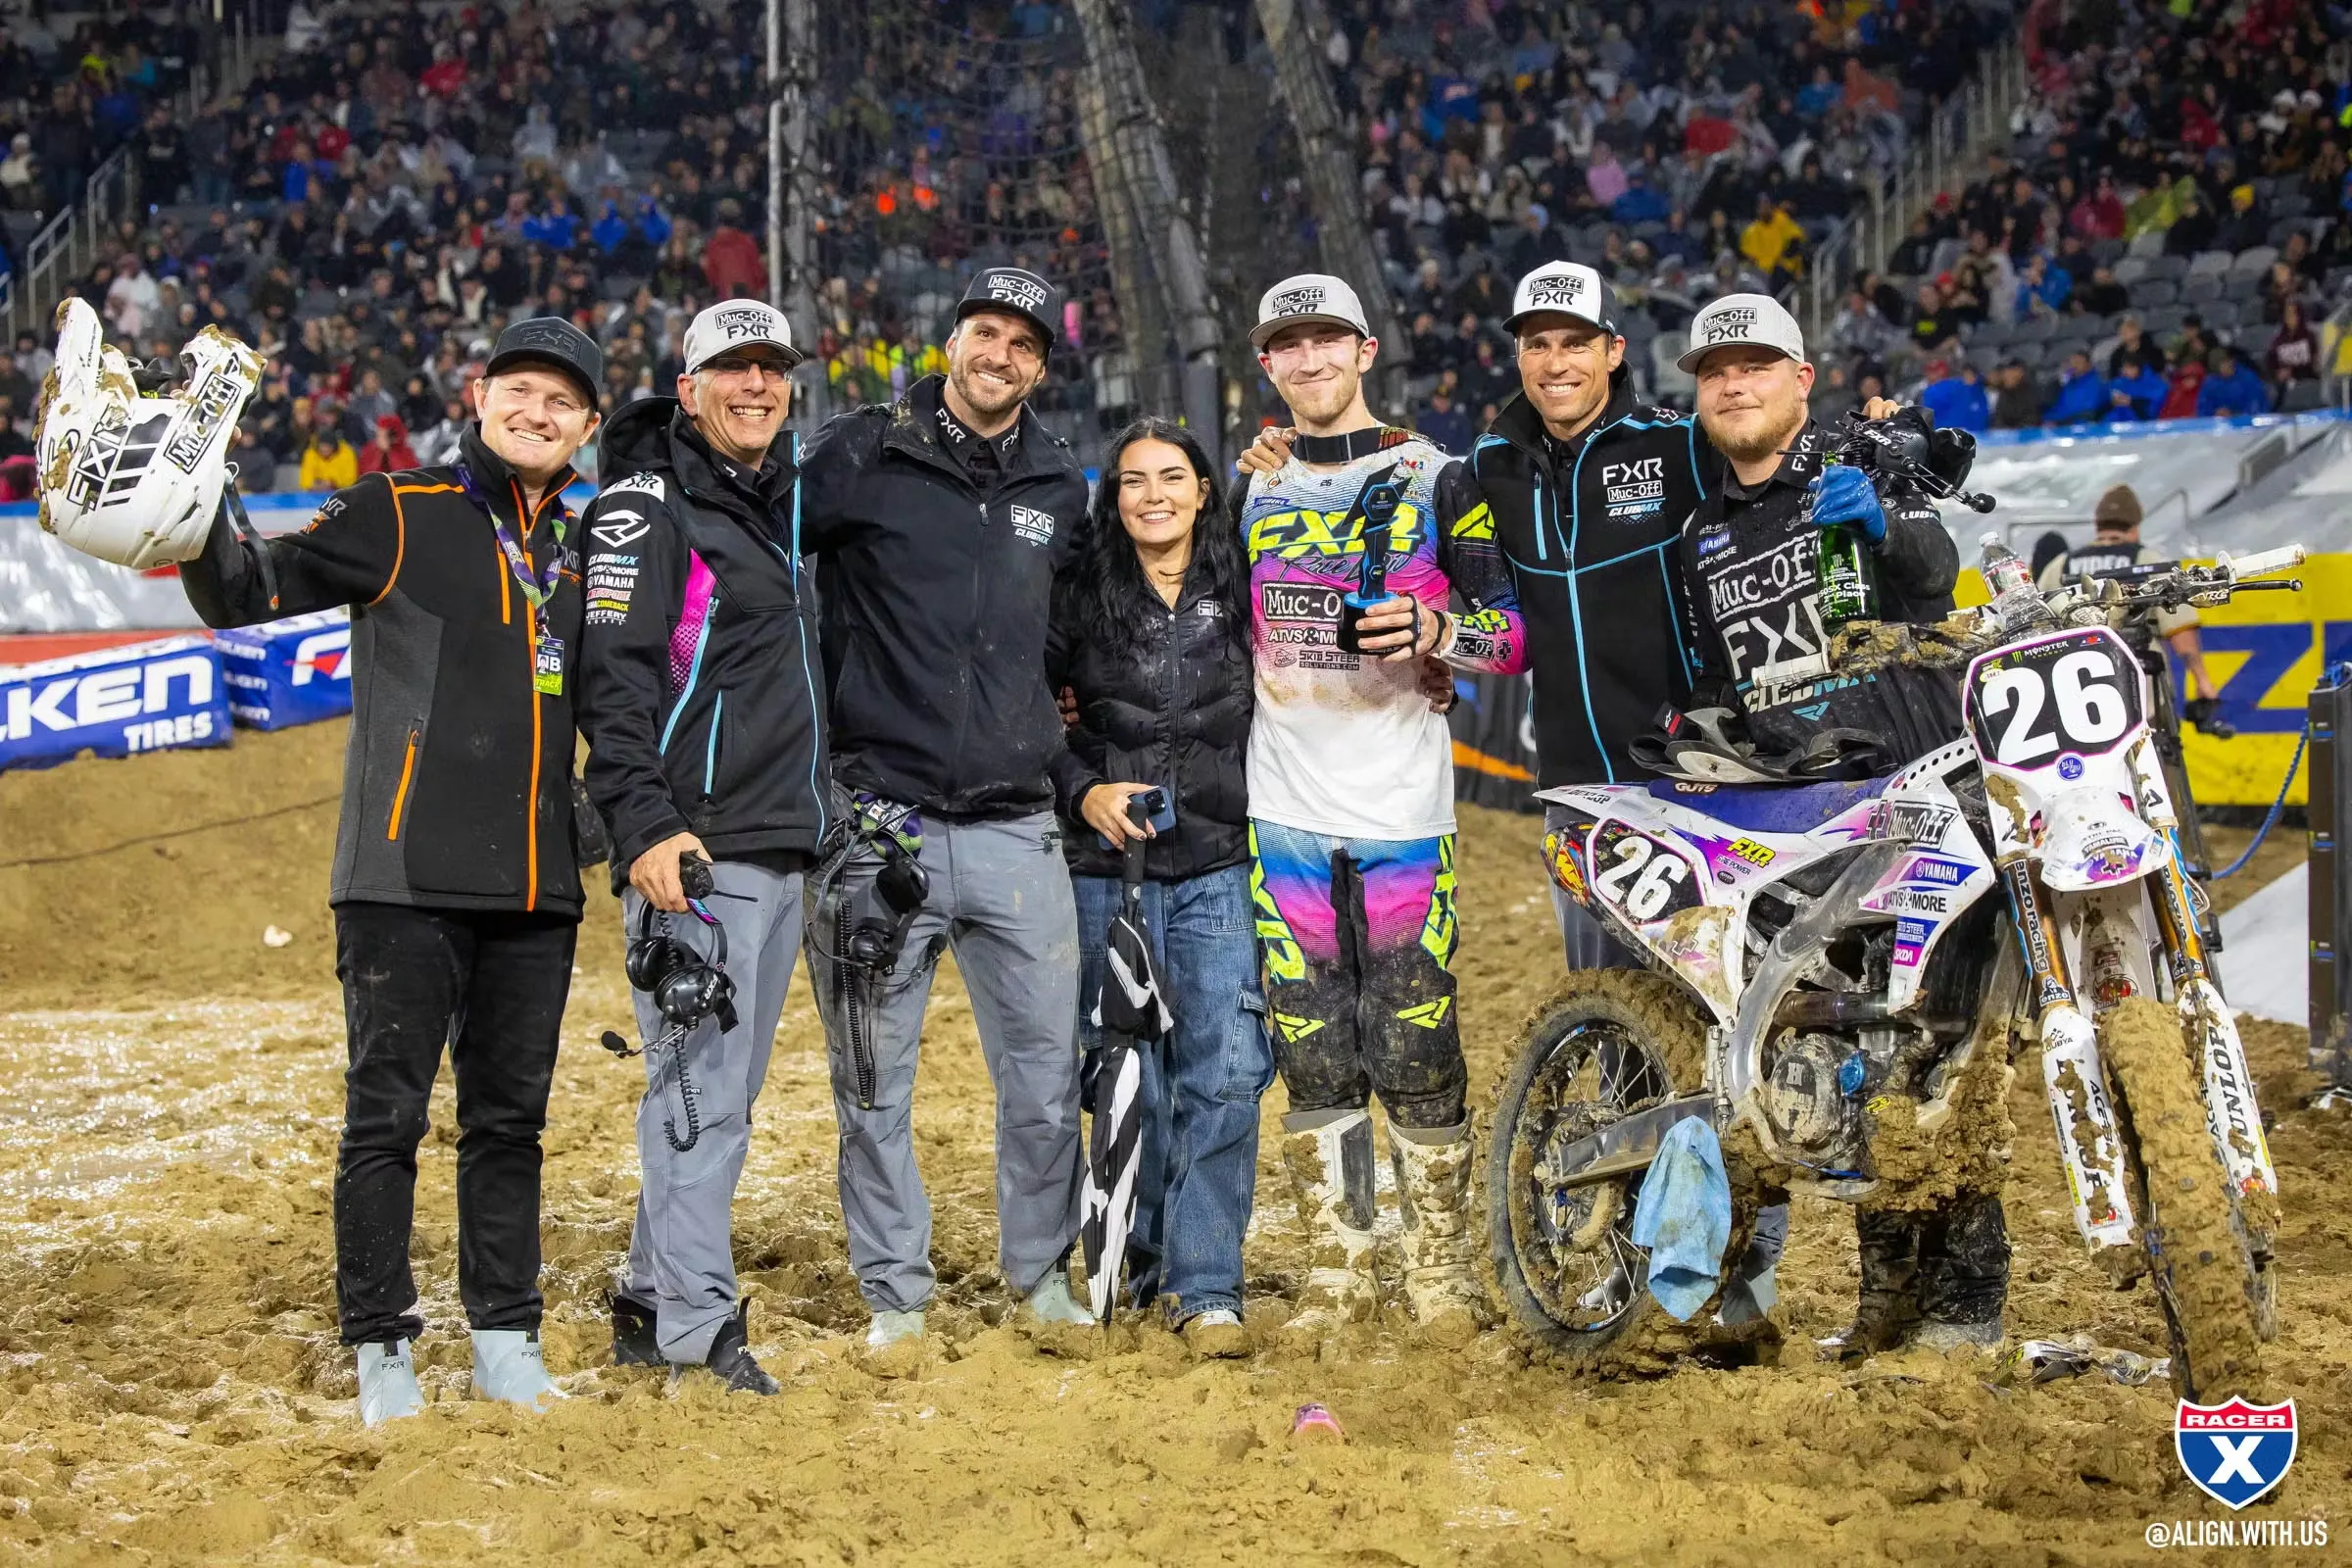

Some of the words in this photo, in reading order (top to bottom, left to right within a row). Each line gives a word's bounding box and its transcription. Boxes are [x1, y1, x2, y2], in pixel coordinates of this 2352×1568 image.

[990, 276, 1046, 302] Muc-Off
[1530, 276, 1583, 293] Muc-Off
[991, 289, 1035, 312] FXR
[1273, 287, 1325, 309] Muc-Off
[1532, 291, 1574, 306] FXR
[718, 311, 773, 328] Muc-Off
[1703, 308, 1755, 330] Muc-Off
[728, 324, 769, 339] FXR
[1707, 324, 1748, 344] FXR
[171, 376, 236, 467] Muc-Off
[936, 407, 966, 443] FXR
[1863, 429, 1892, 446] FXR
[1791, 433, 1816, 472] FXR
[1602, 458, 1664, 485] FXR
[1609, 482, 1660, 501] Muc-Off
[1011, 505, 1054, 535] FXR
[1248, 502, 1421, 568] FXR
[594, 574, 635, 589] YAMAHA
[1266, 589, 1343, 617] Muc-O
[586, 610, 627, 620] JEFFERY
[1268, 627, 1338, 646] ATVS&M
[1299, 650, 1323, 662] SKID
[1325, 651, 1360, 663] STEER
[2024, 640, 2070, 657] MONSTER
[1299, 662, 1360, 670] SOLUTIONS.COM
[1982, 650, 2128, 766] 26
[123, 711, 213, 753] TIRES
[1675, 782, 1718, 793] GUTS
[1890, 807, 1952, 844] Muc-Off
[1726, 836, 1777, 869] FXR
[1729, 860, 1752, 875] POWER
[1924, 862, 1959, 882] YAMAHA
[1595, 836, 1688, 920] 26
[2175, 962, 2202, 977] eno
[2040, 991, 2069, 1005] enzo
[521, 1350, 541, 1360] FXR
[381, 1360, 406, 1372] FXR
